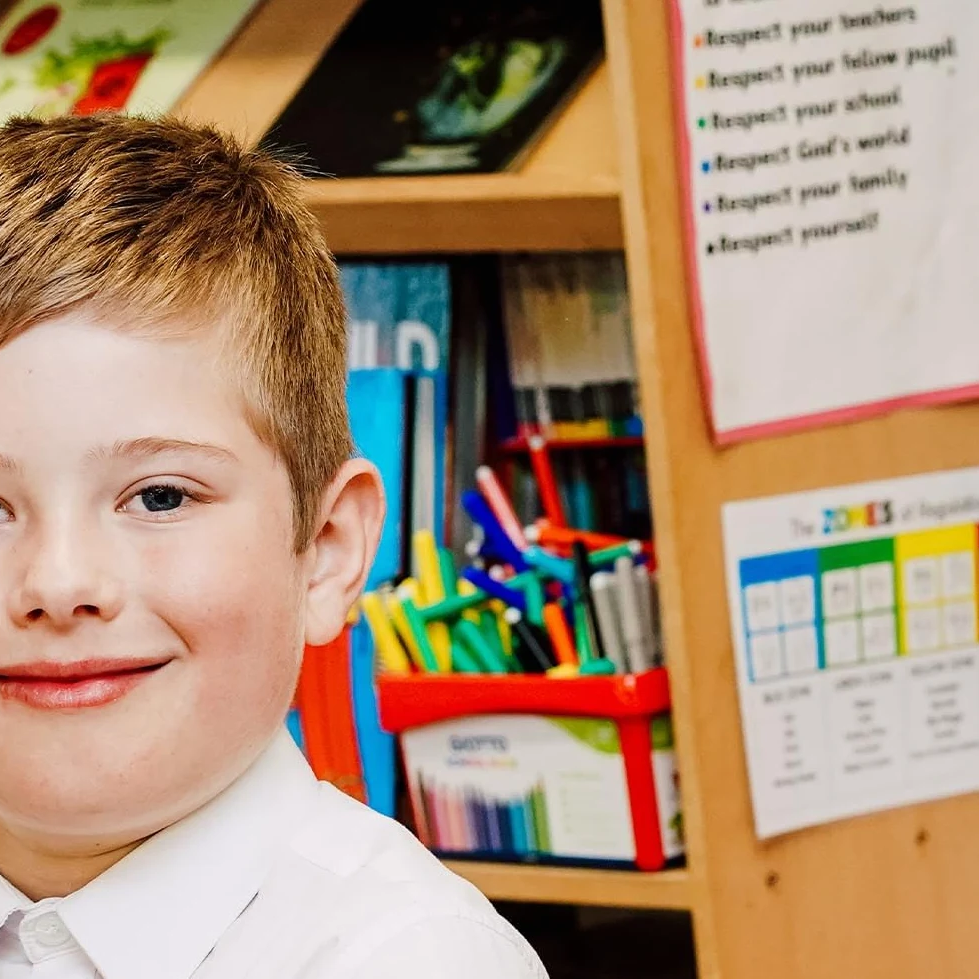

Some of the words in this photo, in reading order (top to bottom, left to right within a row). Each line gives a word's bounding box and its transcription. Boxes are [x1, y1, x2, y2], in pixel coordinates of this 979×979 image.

[707, 23, 781, 47] Respect
[790, 19, 832, 42] your
[839, 7, 917, 30] teachers
[709, 65, 784, 88] Respect
[793, 60, 835, 84] your
[842, 48, 899, 71] fellow
[712, 106, 786, 130] Respect
[796, 101, 837, 125] your
[844, 86, 902, 112] school
[716, 146, 790, 173] Respect
[797, 136, 850, 160] God's
[858, 127, 910, 150] world
[718, 187, 792, 213] Respect
[800, 182, 841, 206] your
[848, 167, 908, 193] family
[720, 228, 793, 255] Respect
[801, 212, 879, 248] yourself
[822, 501, 894, 535] ZONES
